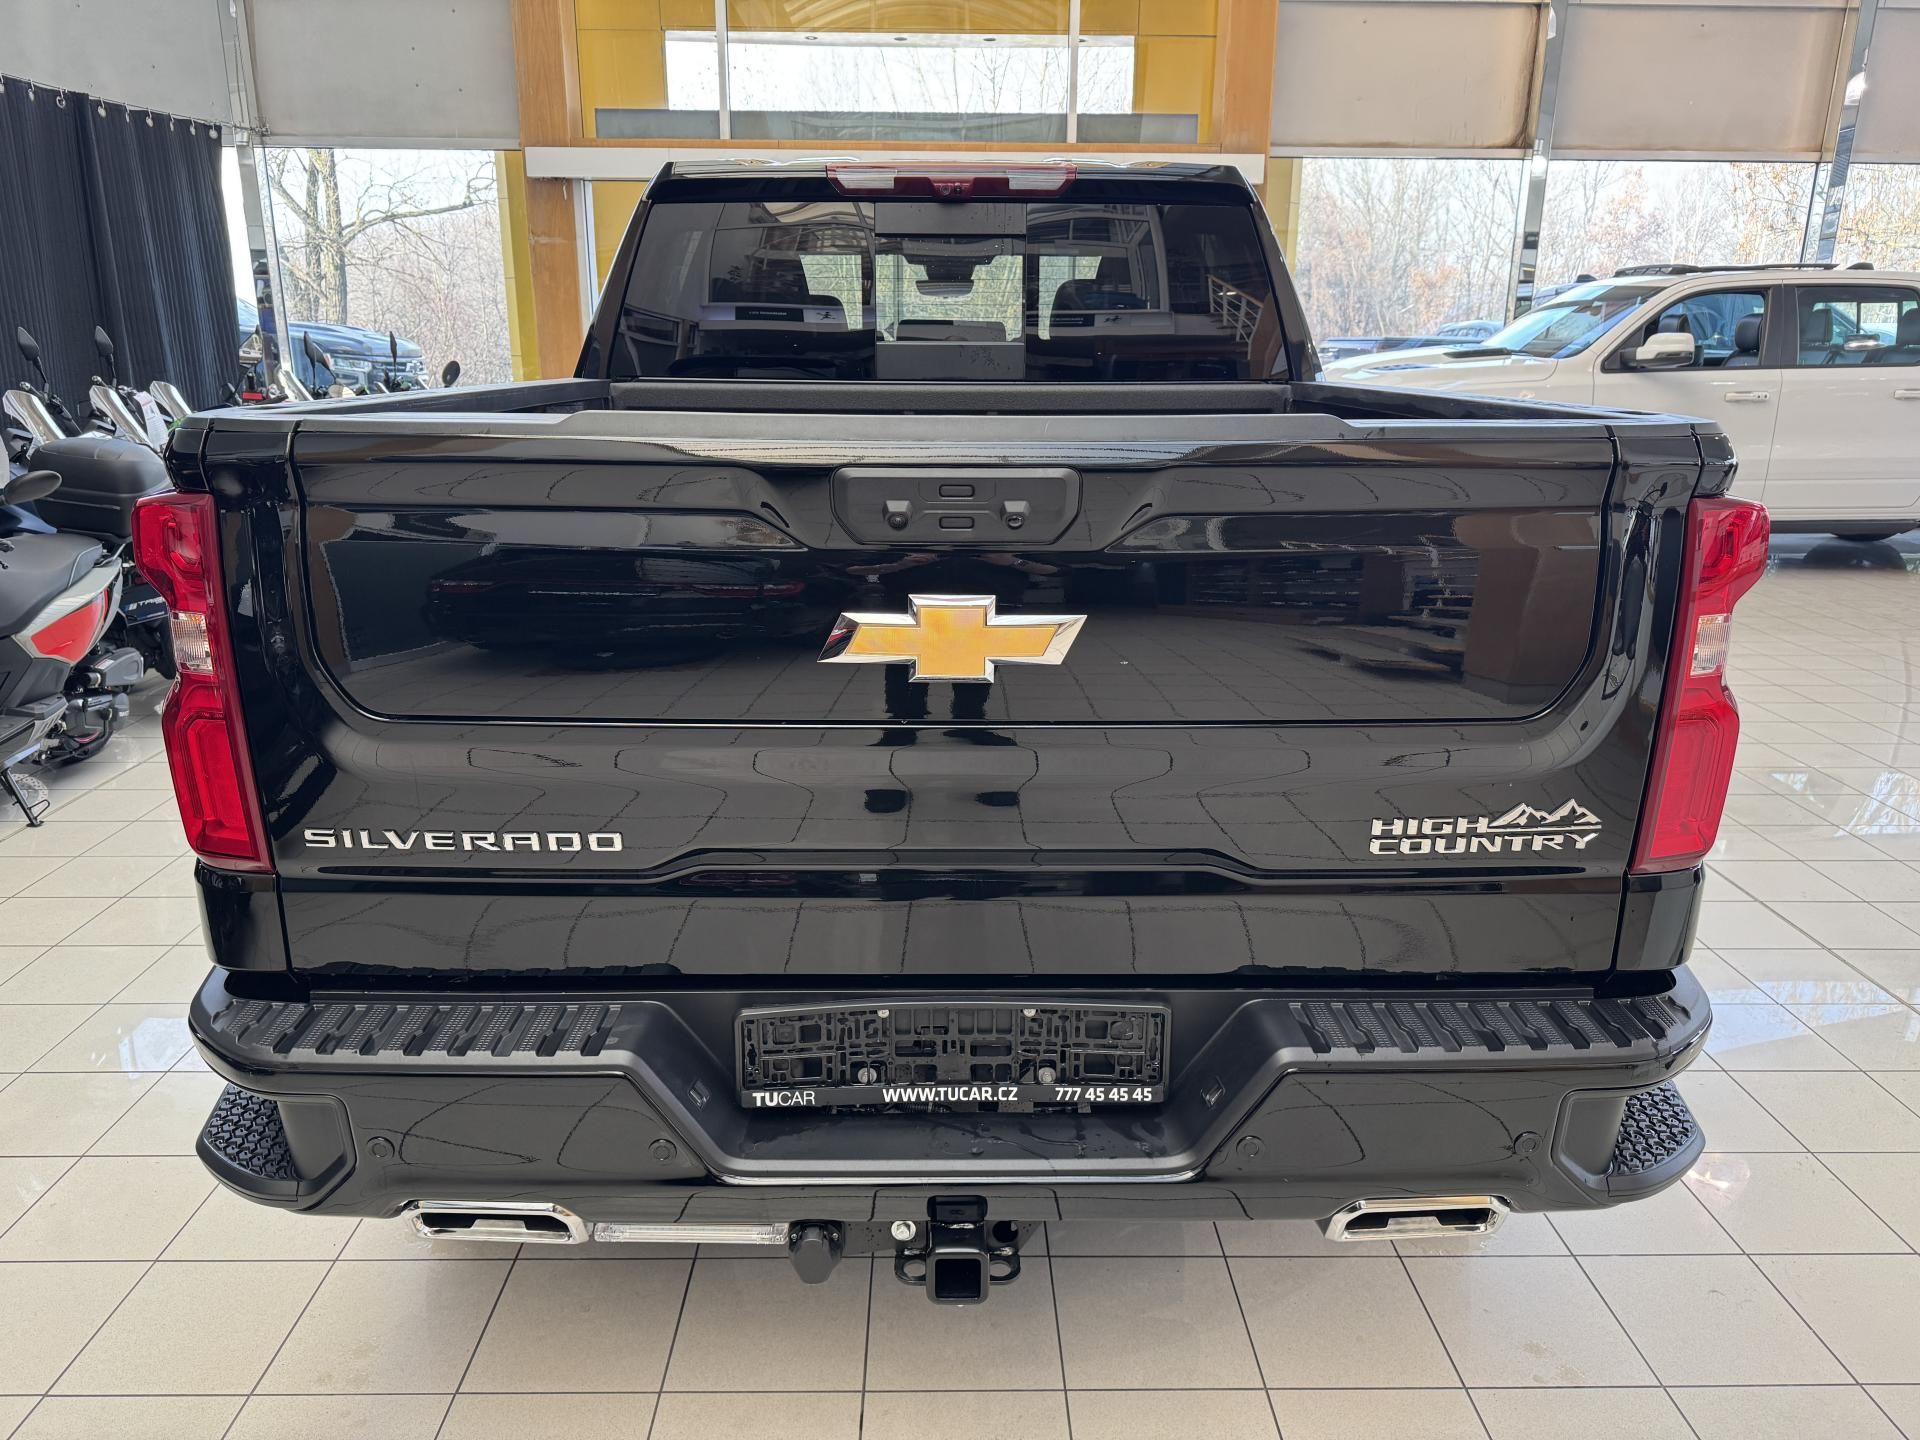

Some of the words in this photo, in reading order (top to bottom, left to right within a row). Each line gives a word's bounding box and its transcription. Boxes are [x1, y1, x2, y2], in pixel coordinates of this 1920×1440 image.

[1371, 817, 1489, 835] HIGH
[303, 828, 623, 852] SILVERADO
[1369, 833, 1600, 854] COUNTRY
[752, 1090, 816, 1107] TUCAR
[882, 1086, 1018, 1102] WWW.TUCAR.CZ
[1055, 1087, 1082, 1101] 777
[1085, 1087, 1105, 1102] 45
[1108, 1087, 1129, 1102] 45
[1132, 1087, 1152, 1102] 45
